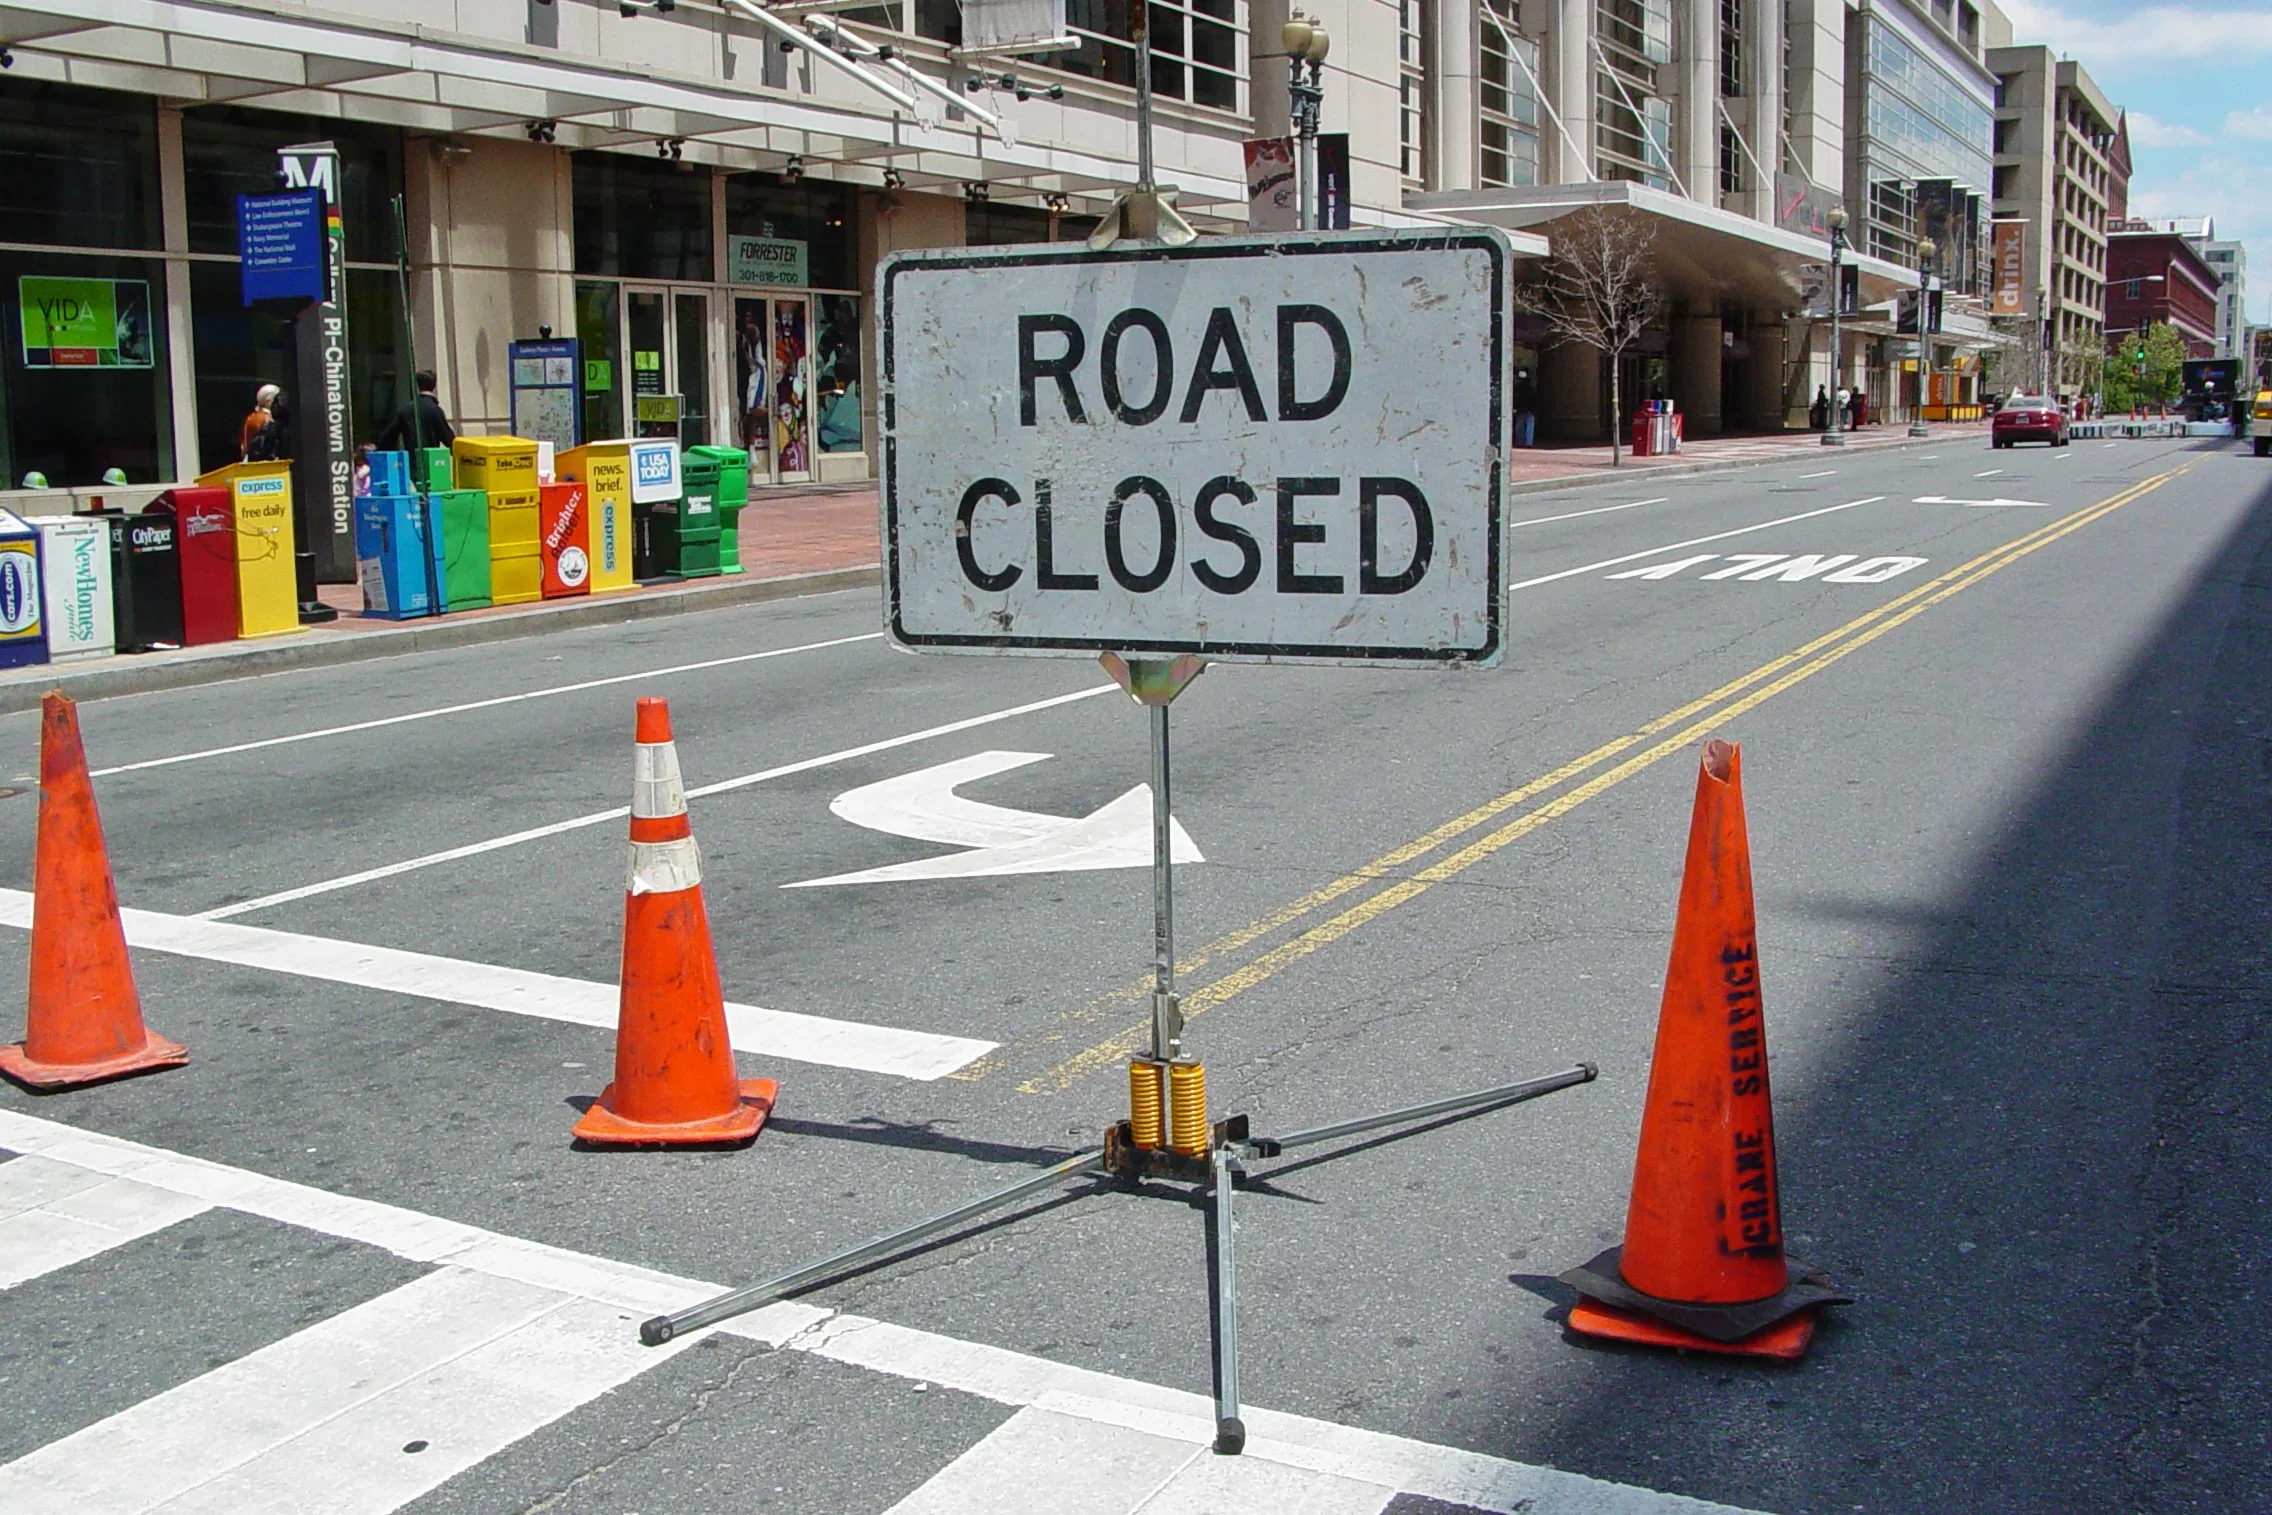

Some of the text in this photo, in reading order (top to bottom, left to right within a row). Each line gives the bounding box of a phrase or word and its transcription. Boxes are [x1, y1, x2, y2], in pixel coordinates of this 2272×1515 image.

[283, 156, 334, 203] M
[740, 242, 798, 262] FORRESTER
[1998, 229, 2019, 307] drinx.
[37, 298, 96, 322] VIDA
[588, 363, 610, 380] DA
[1017, 303, 1352, 427] ROAD
[593, 464, 624, 476] news.
[640, 464, 670, 480] TODAY
[649, 453, 669, 466] USA
[242, 480, 283, 493] express
[330, 461, 349, 534] Station
[596, 478, 622, 492] brief.
[241, 504, 286, 519] free daily
[546, 491, 582, 548] Brighter.
[605, 506, 614, 570] express
[955, 475, 1434, 595] CLOSED
[26, 561, 34, 601] Magazine
[1603, 553, 1930, 583] ONLY
[4, 563, 16, 621] cars.com
[73, 536, 98, 642] NewHomes
[1721, 941, 1772, 1245] CRANE SERVICE
